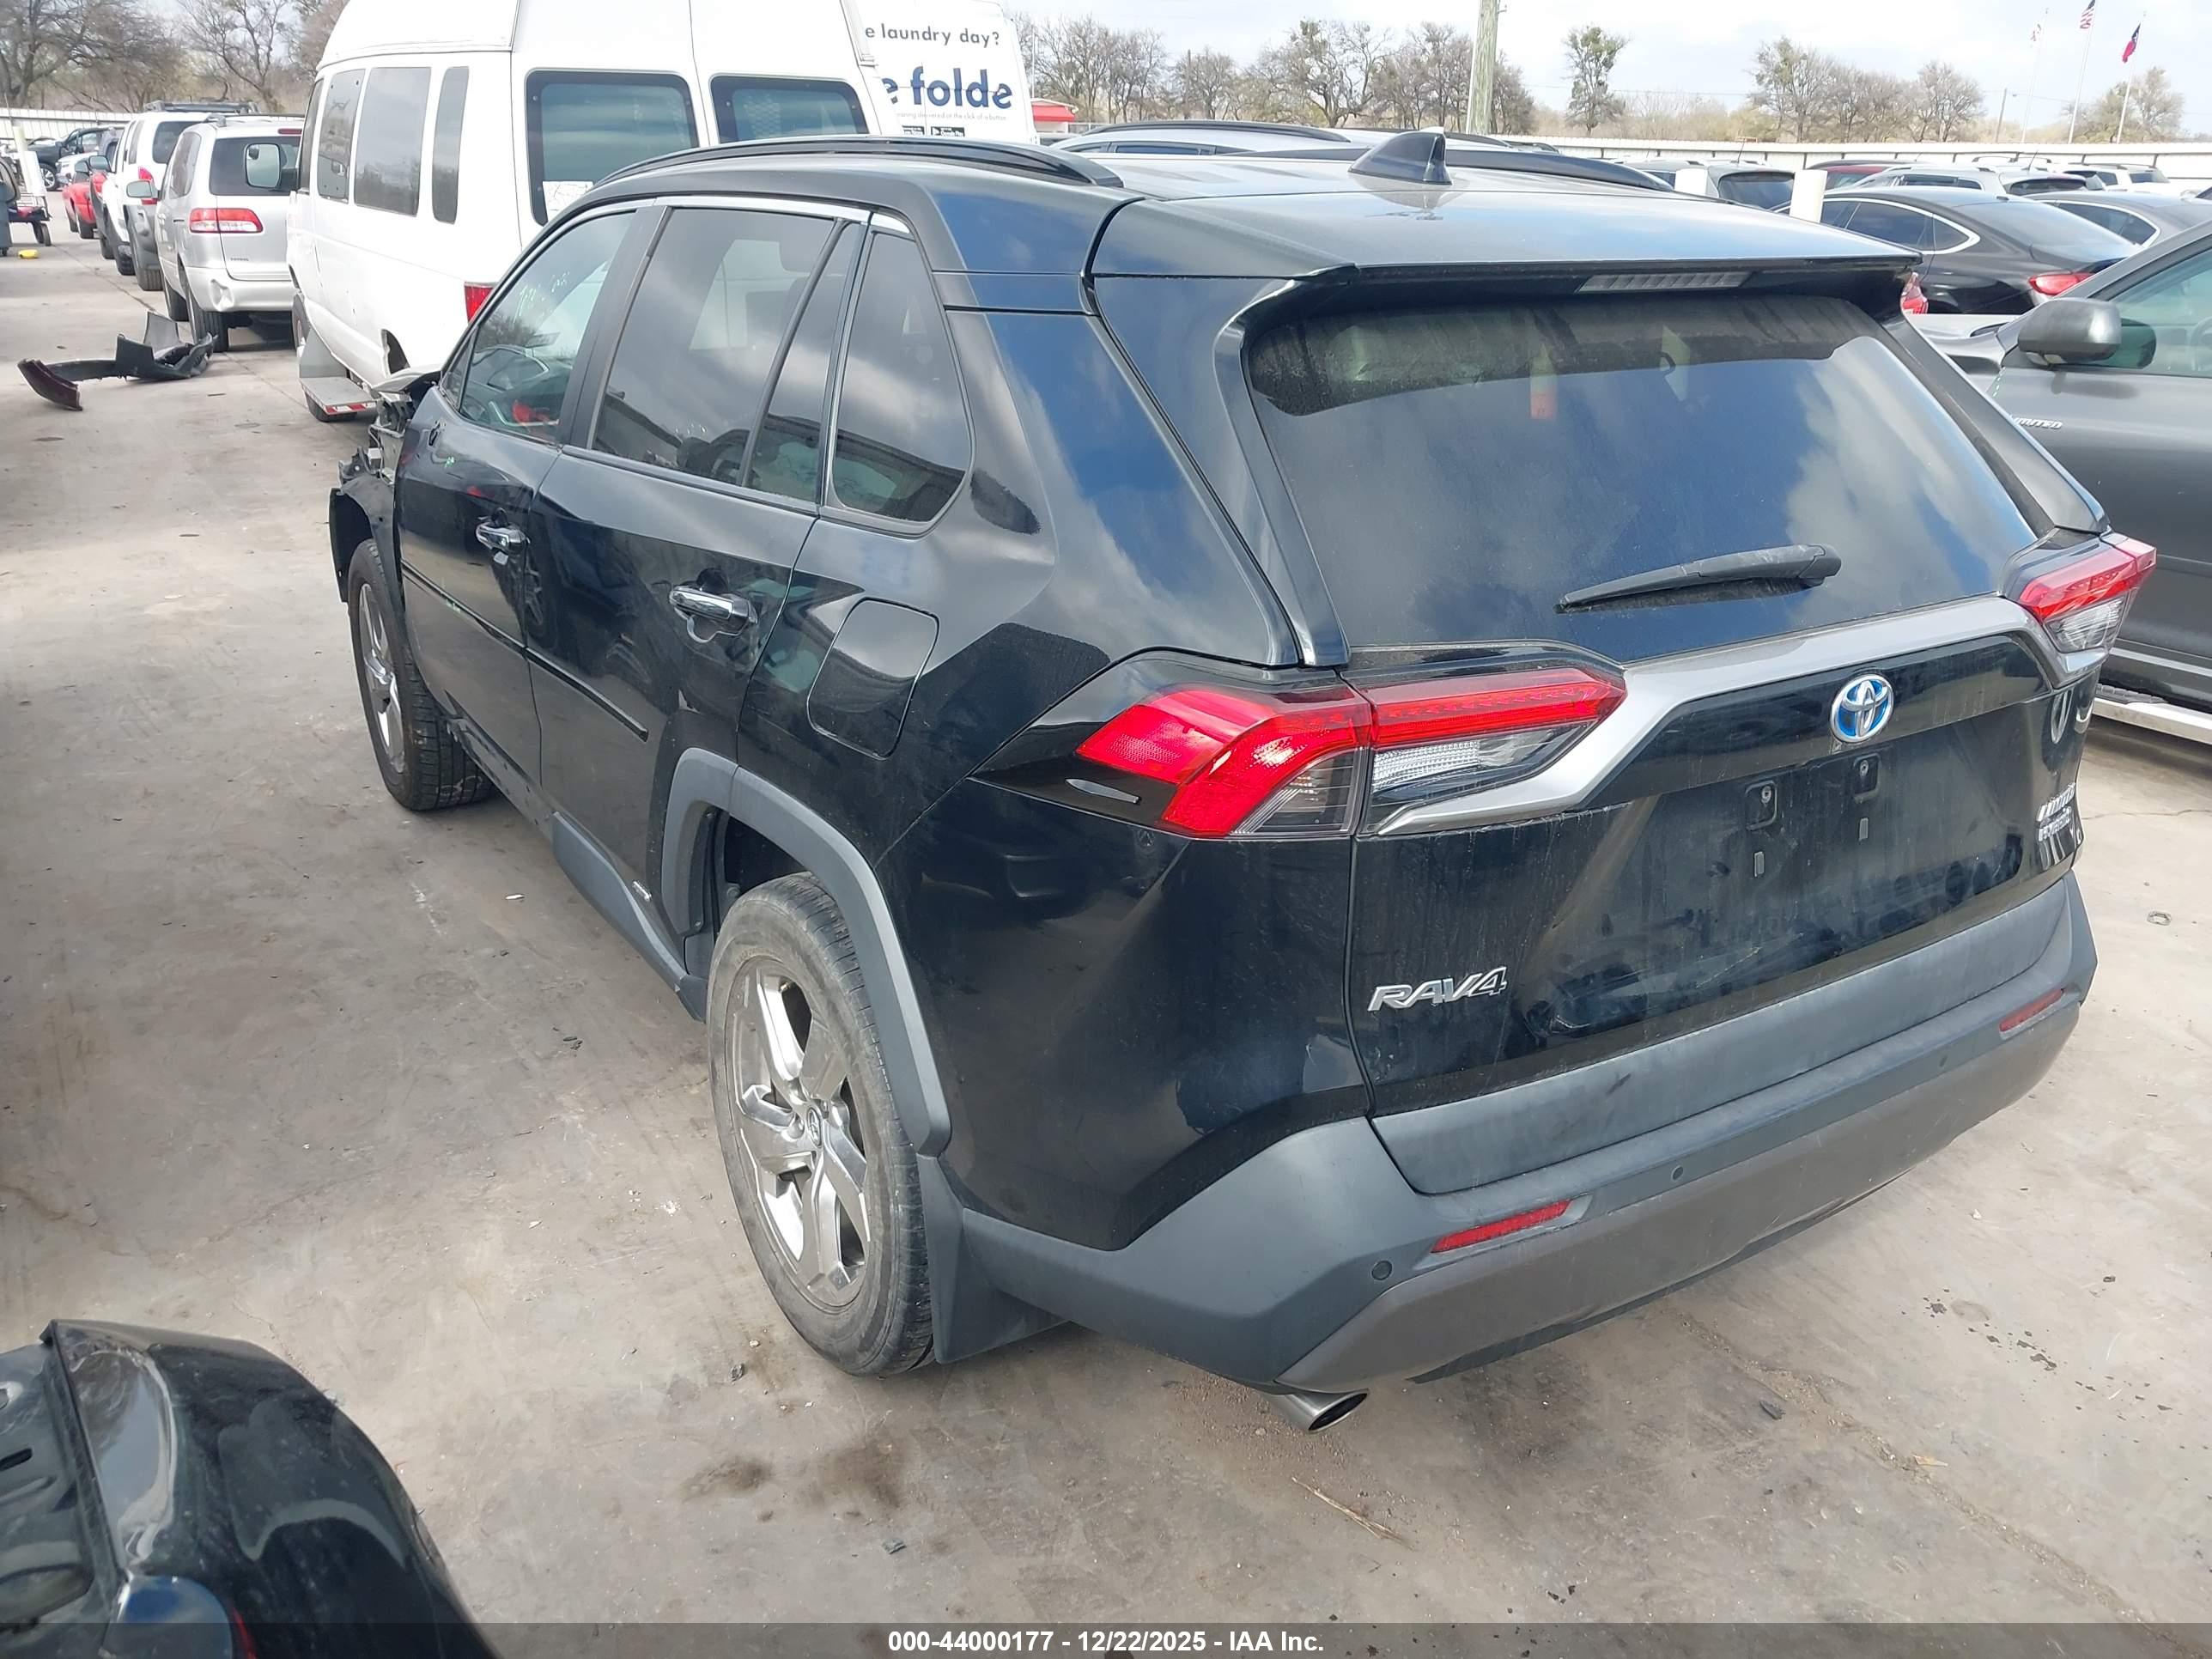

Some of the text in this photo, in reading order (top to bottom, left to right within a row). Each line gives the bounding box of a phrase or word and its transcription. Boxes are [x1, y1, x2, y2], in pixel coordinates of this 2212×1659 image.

[881, 23, 951, 46] laundry
[959, 27, 1000, 48] day?
[910, 65, 1012, 109] folde
[1367, 966, 1507, 1012] RAV4
